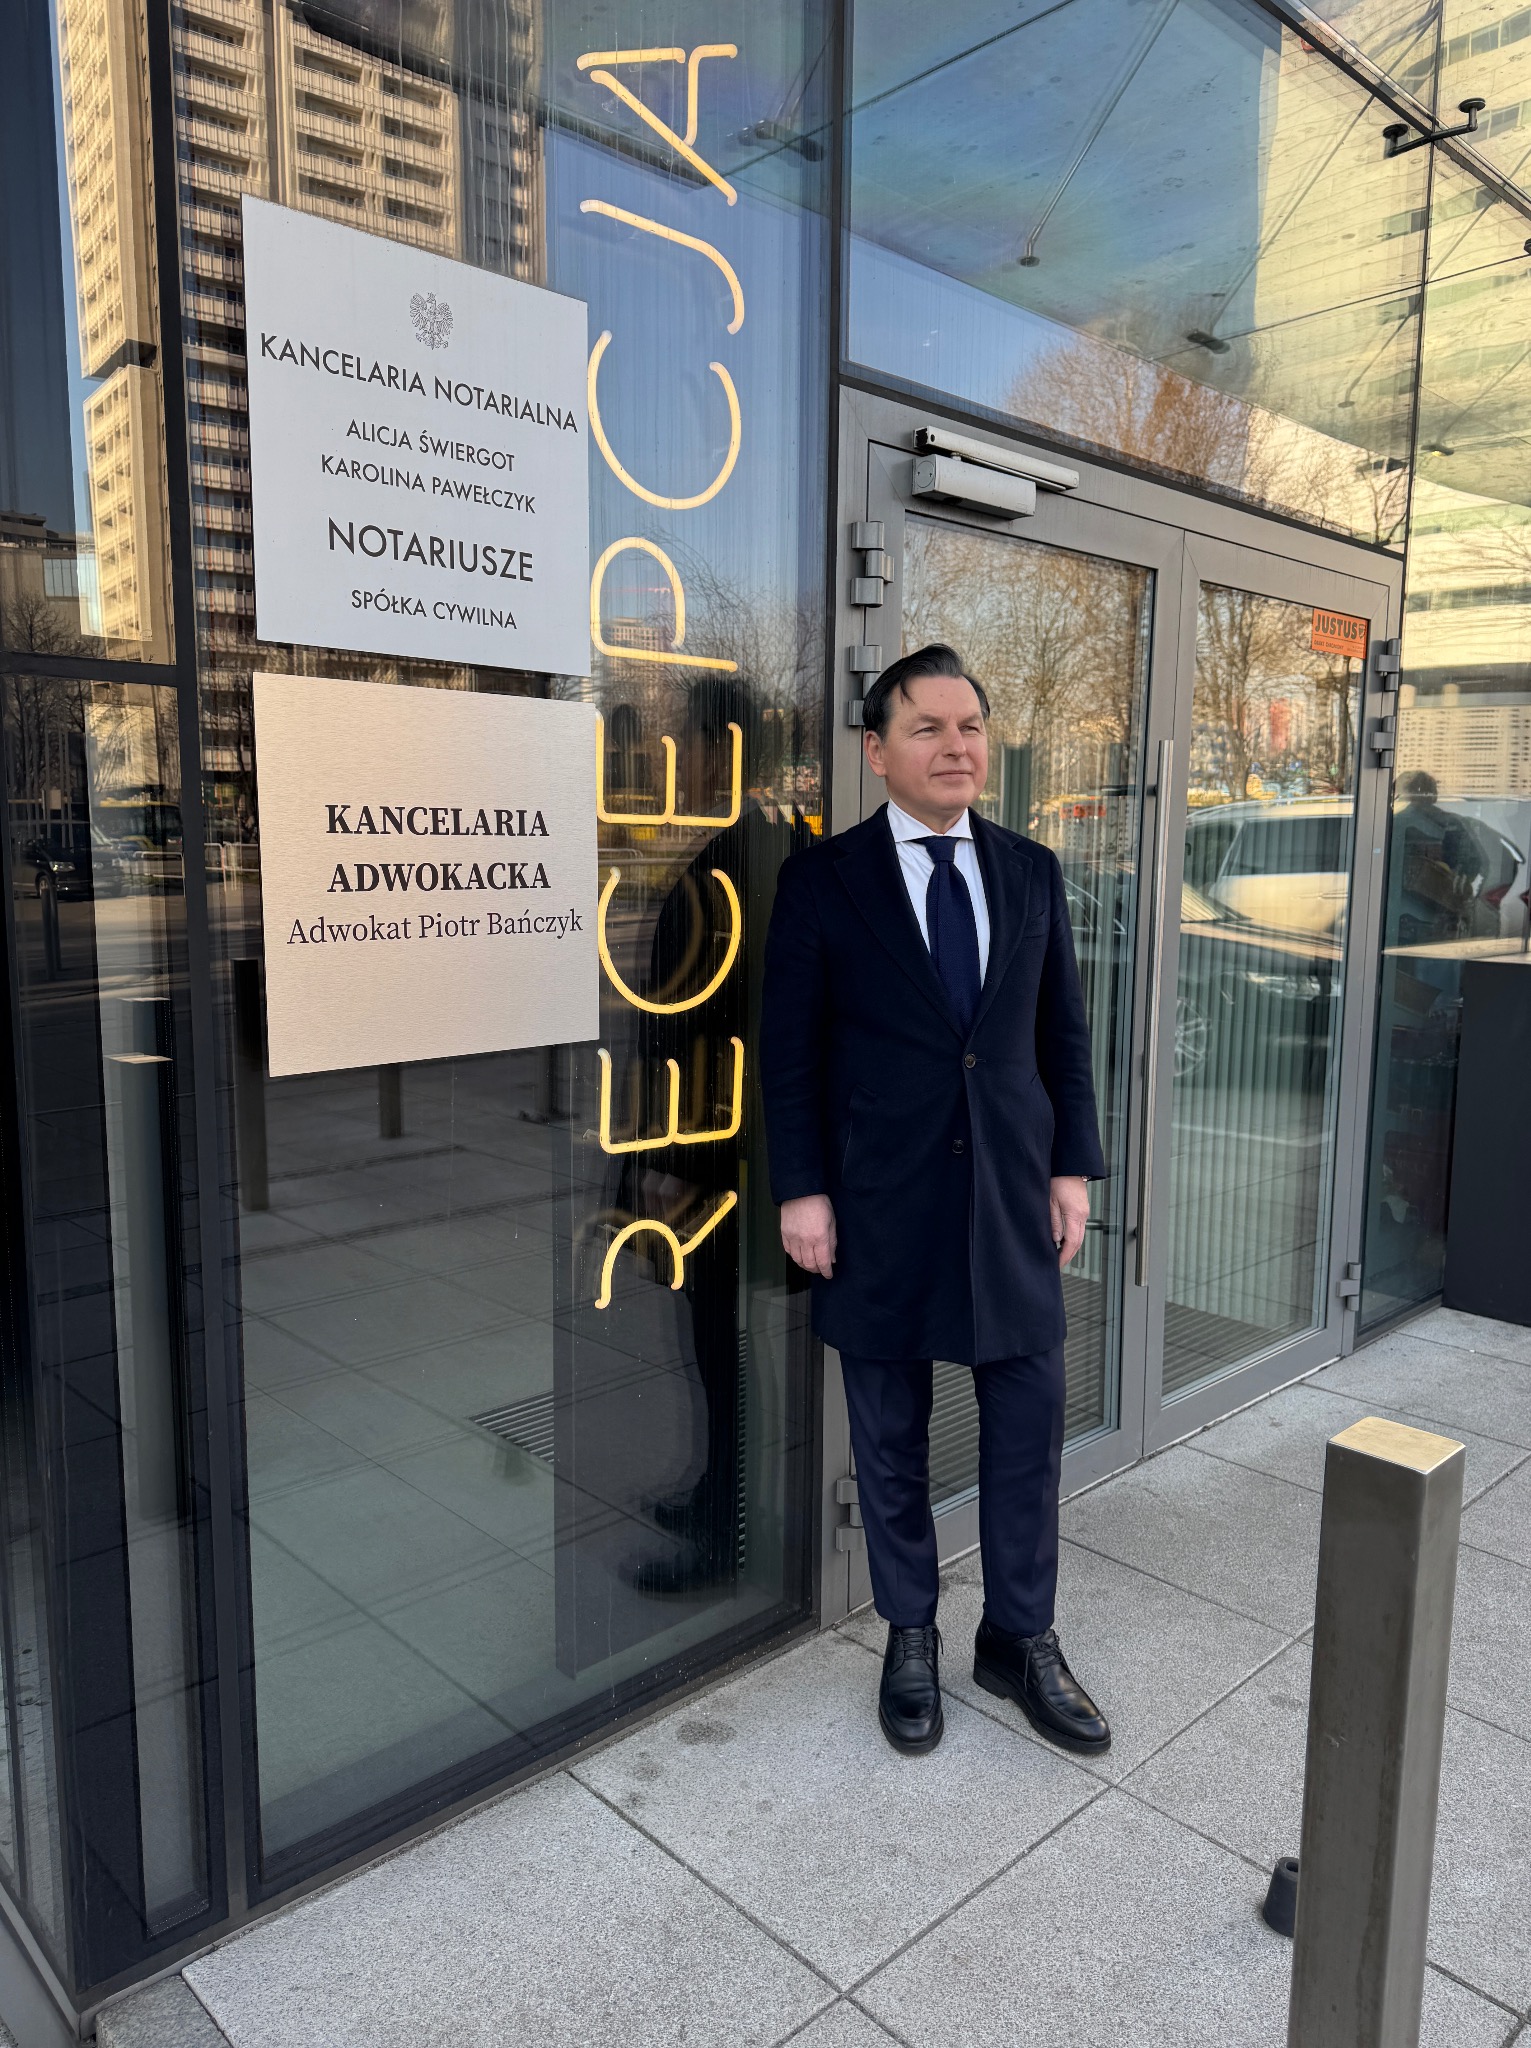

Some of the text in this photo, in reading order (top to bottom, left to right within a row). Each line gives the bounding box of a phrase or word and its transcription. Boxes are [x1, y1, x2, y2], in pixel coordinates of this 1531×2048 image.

[260, 332, 578, 433] KANCELARIA NOTARIALNA
[346, 419, 515, 472] ALICJA ŚWIERGOT
[321, 454, 536, 514] KAROLINA PAWEŁCZYK
[328, 517, 534, 582] NOTARIUSZE
[351, 588, 517, 630] SPÓŁKA CYWILNA
[1315, 614, 1357, 639] JUSTUS
[577, 43, 745, 1309] RECEPCJA
[325, 804, 549, 837] KANCELARIA
[327, 862, 551, 892] ADWOKACKA
[286, 908, 583, 945] Adwokat Piotr Bańczyk
